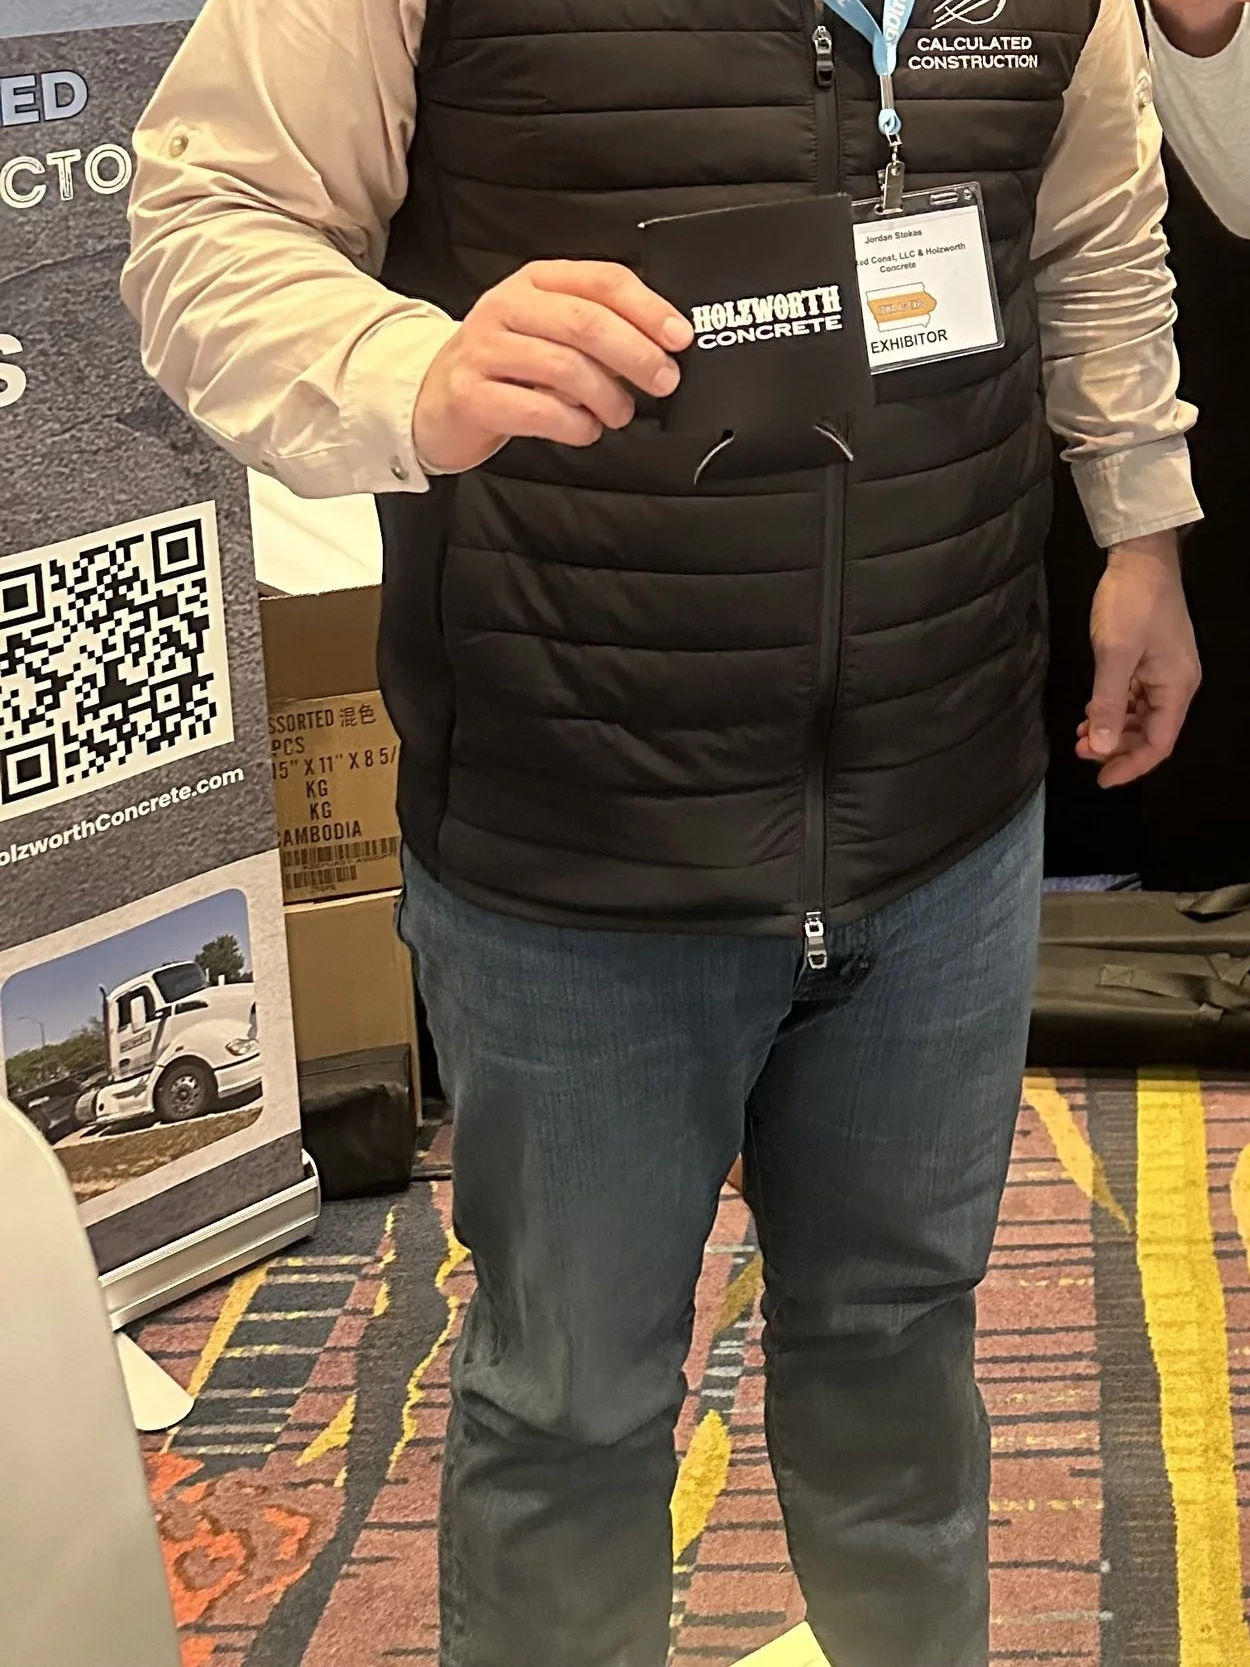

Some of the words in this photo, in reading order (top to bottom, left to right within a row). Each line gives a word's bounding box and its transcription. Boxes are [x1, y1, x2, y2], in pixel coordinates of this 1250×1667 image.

[917, 36, 1032, 51] CALCULATED
[908, 55, 1038, 69] CONSTRUCTION
[864, 233, 893, 245] Jordan
[895, 229, 922, 240] Stokes
[871, 253, 898, 265] Const,
[899, 250, 916, 260] LLC
[918, 248, 925, 257] &
[926, 243, 966, 256] Holzworth
[880, 261, 917, 273] Concrete
[691, 285, 842, 333] HOLZWORTH
[697, 315, 842, 349] CONCRETE
[871, 329, 948, 354] EXHIBITOR
[339, 703, 377, 728] 混色
[272, 736, 305, 757] PCS
[304, 759, 315, 776] X
[319, 754, 343, 773] 11"
[349, 752, 360, 770] X
[364, 749, 374, 767] 8
[306, 779, 328, 799] KG
[310, 801, 332, 821] KG
